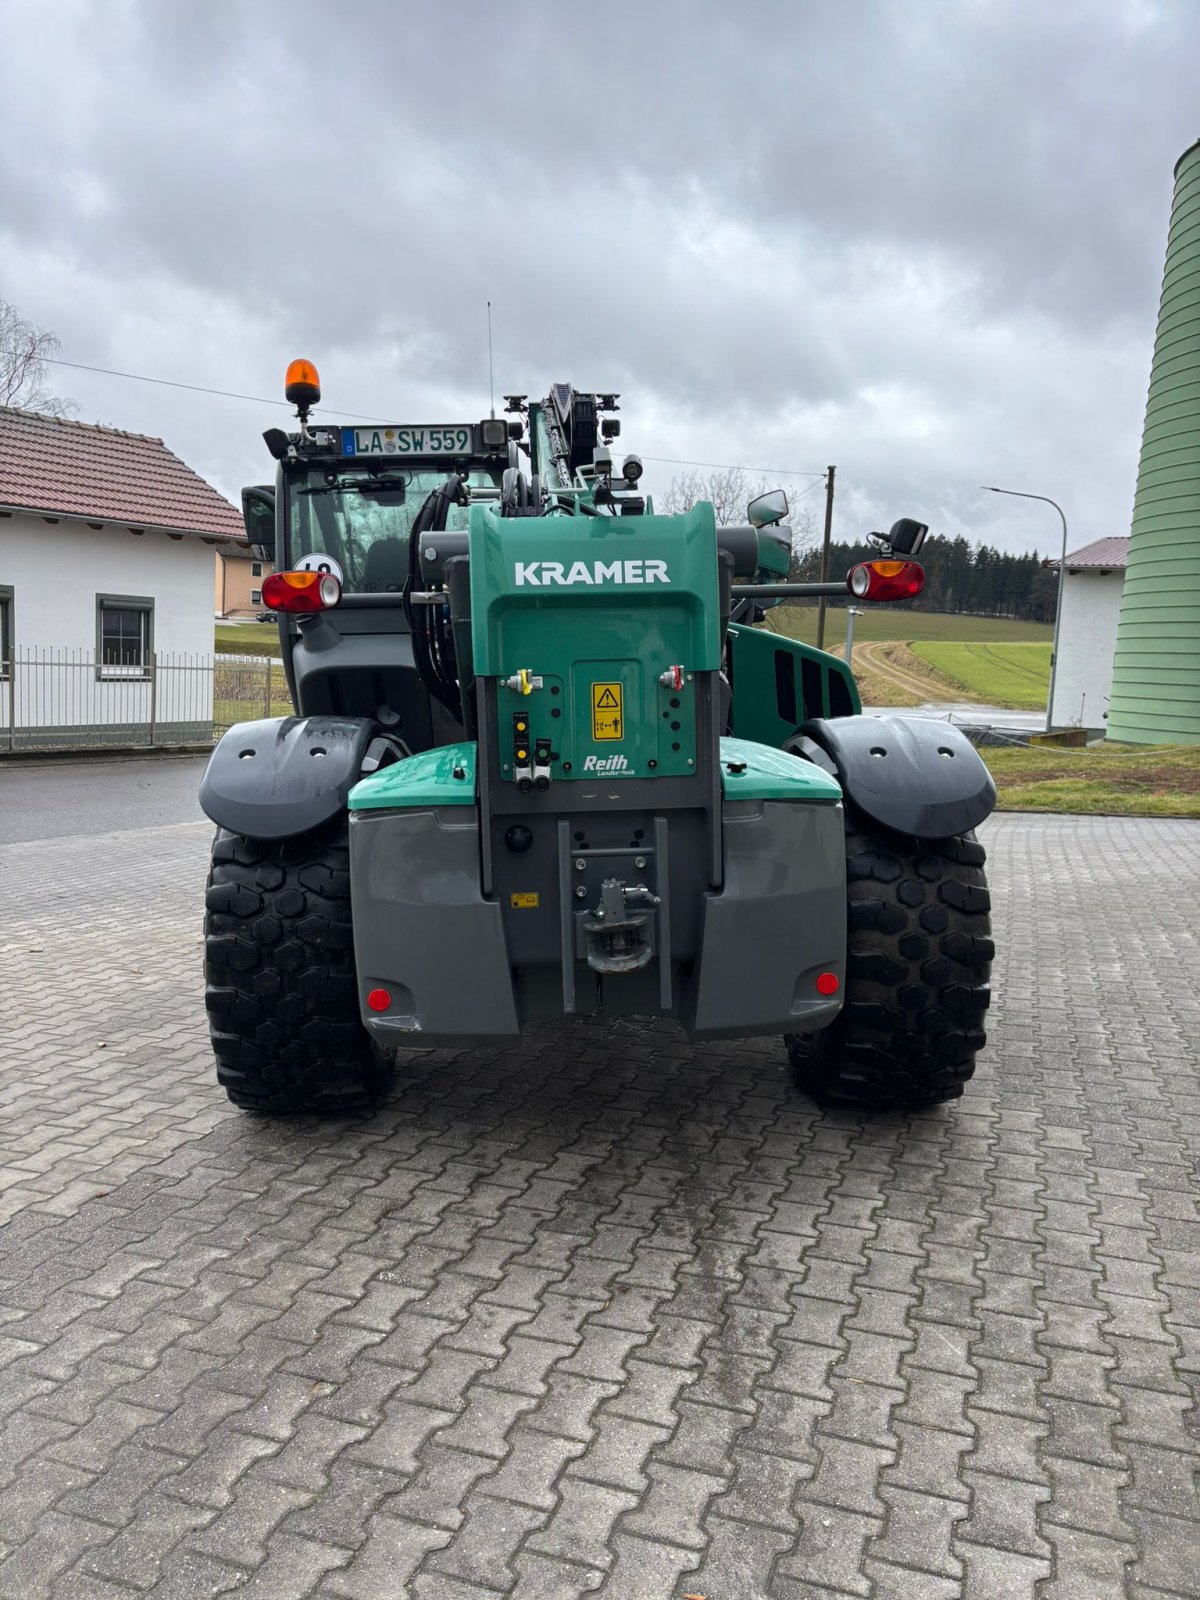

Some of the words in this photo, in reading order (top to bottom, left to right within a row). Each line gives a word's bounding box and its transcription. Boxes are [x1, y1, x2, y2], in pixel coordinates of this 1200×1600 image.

[355, 431, 383, 453] LA
[515, 560, 671, 586] KRAMER
[583, 754, 628, 771] Reith
